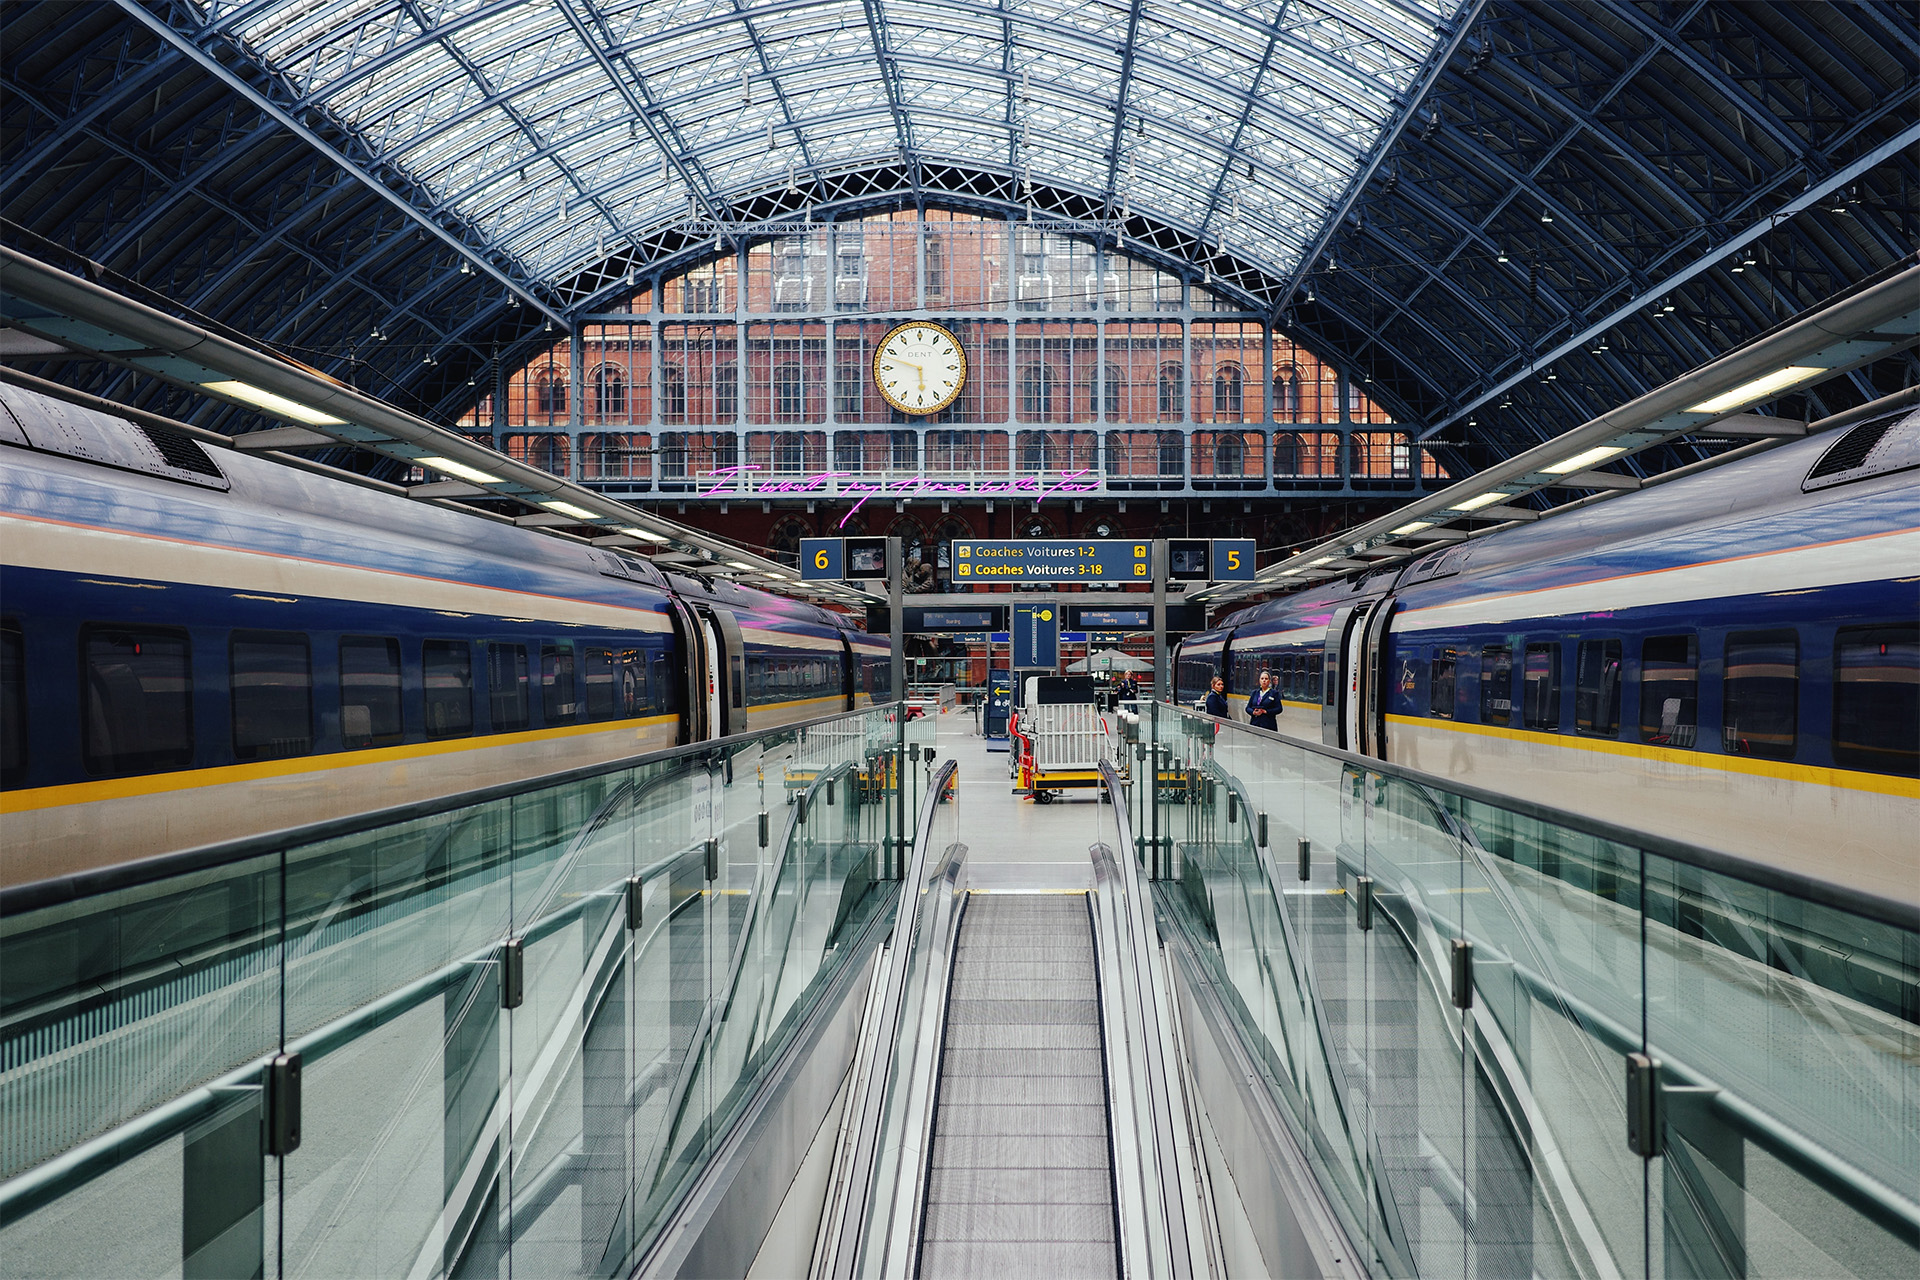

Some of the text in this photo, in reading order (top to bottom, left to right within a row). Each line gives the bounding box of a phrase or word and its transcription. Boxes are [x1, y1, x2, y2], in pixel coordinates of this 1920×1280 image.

[699, 465, 761, 498] I
[758, 471, 851, 493] want
[840, 481, 882, 529] my
[888, 475, 968, 496] time
[814, 549, 829, 570] 6
[975, 546, 1096, 557] Coaches Voitures 1-2
[1227, 550, 1240, 571] 5
[975, 564, 1103, 575] Coaches Voitures 3-18
